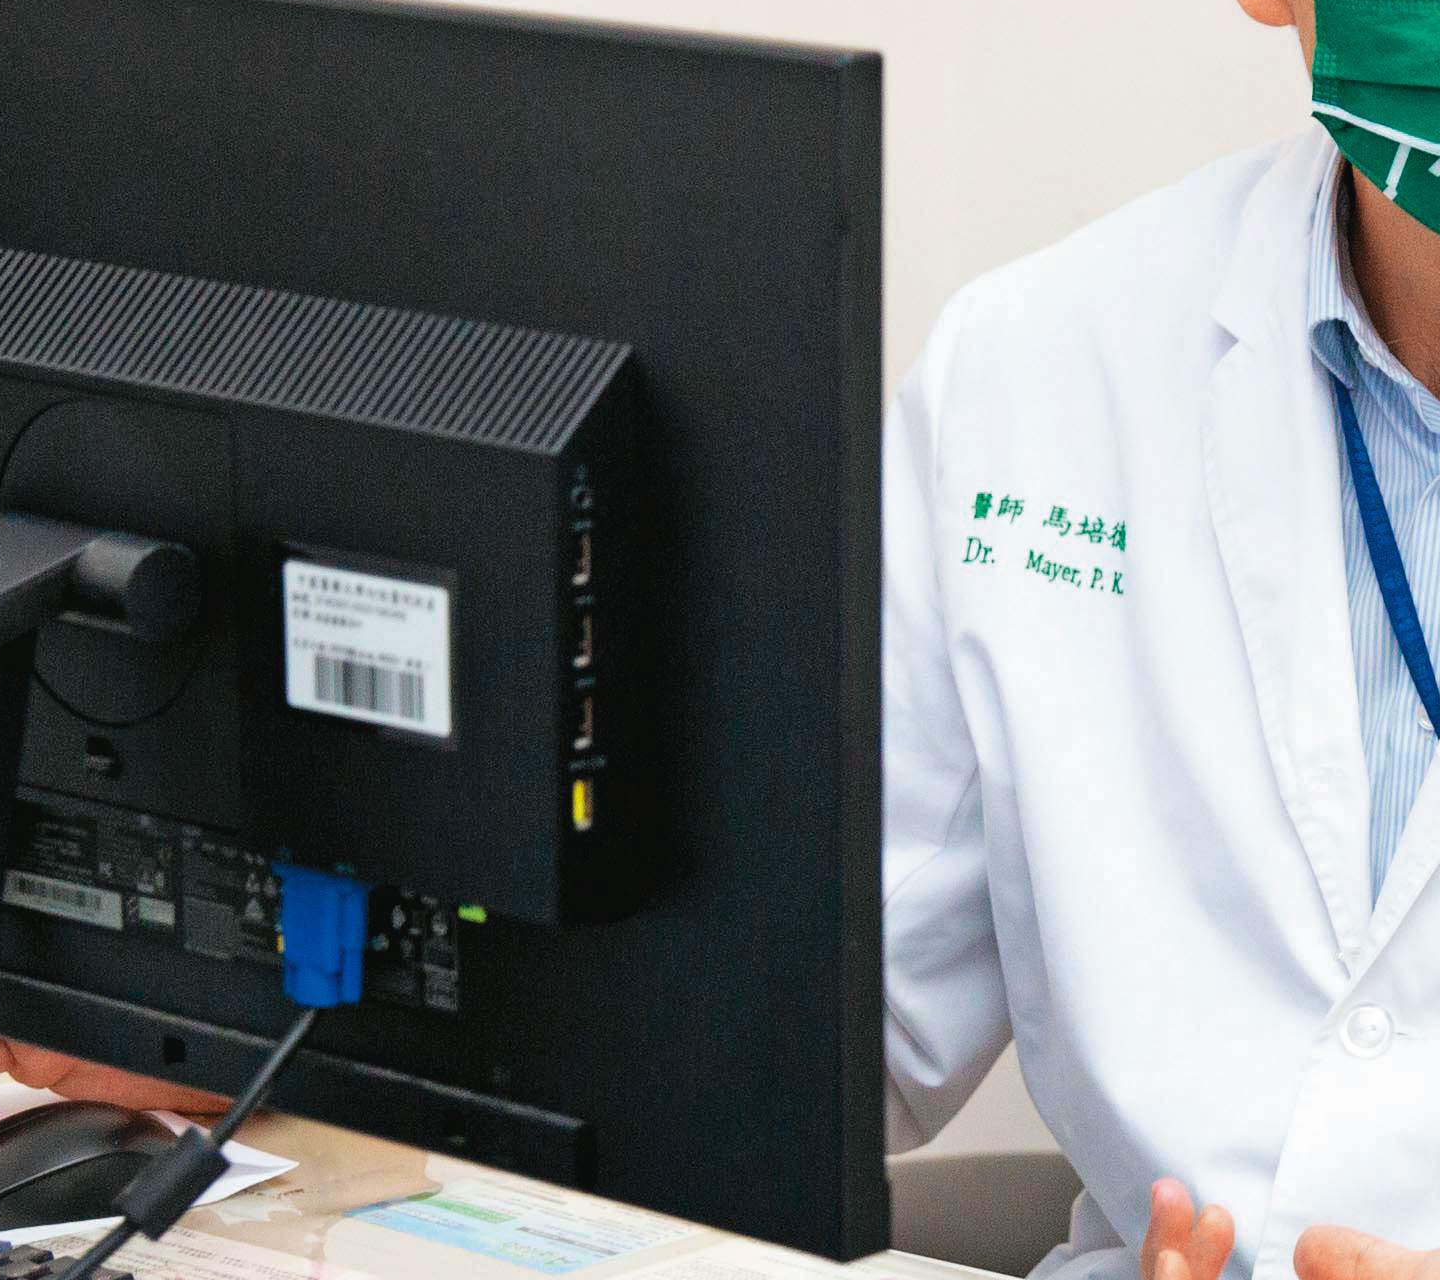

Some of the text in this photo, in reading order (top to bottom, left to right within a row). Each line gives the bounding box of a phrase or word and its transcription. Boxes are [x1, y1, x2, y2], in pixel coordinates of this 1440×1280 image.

[971, 491, 1025, 524] 醫師
[962, 536, 996, 564] Dr.
[1025, 549, 1082, 587] Mayer,
[1090, 568, 1104, 591] P.
